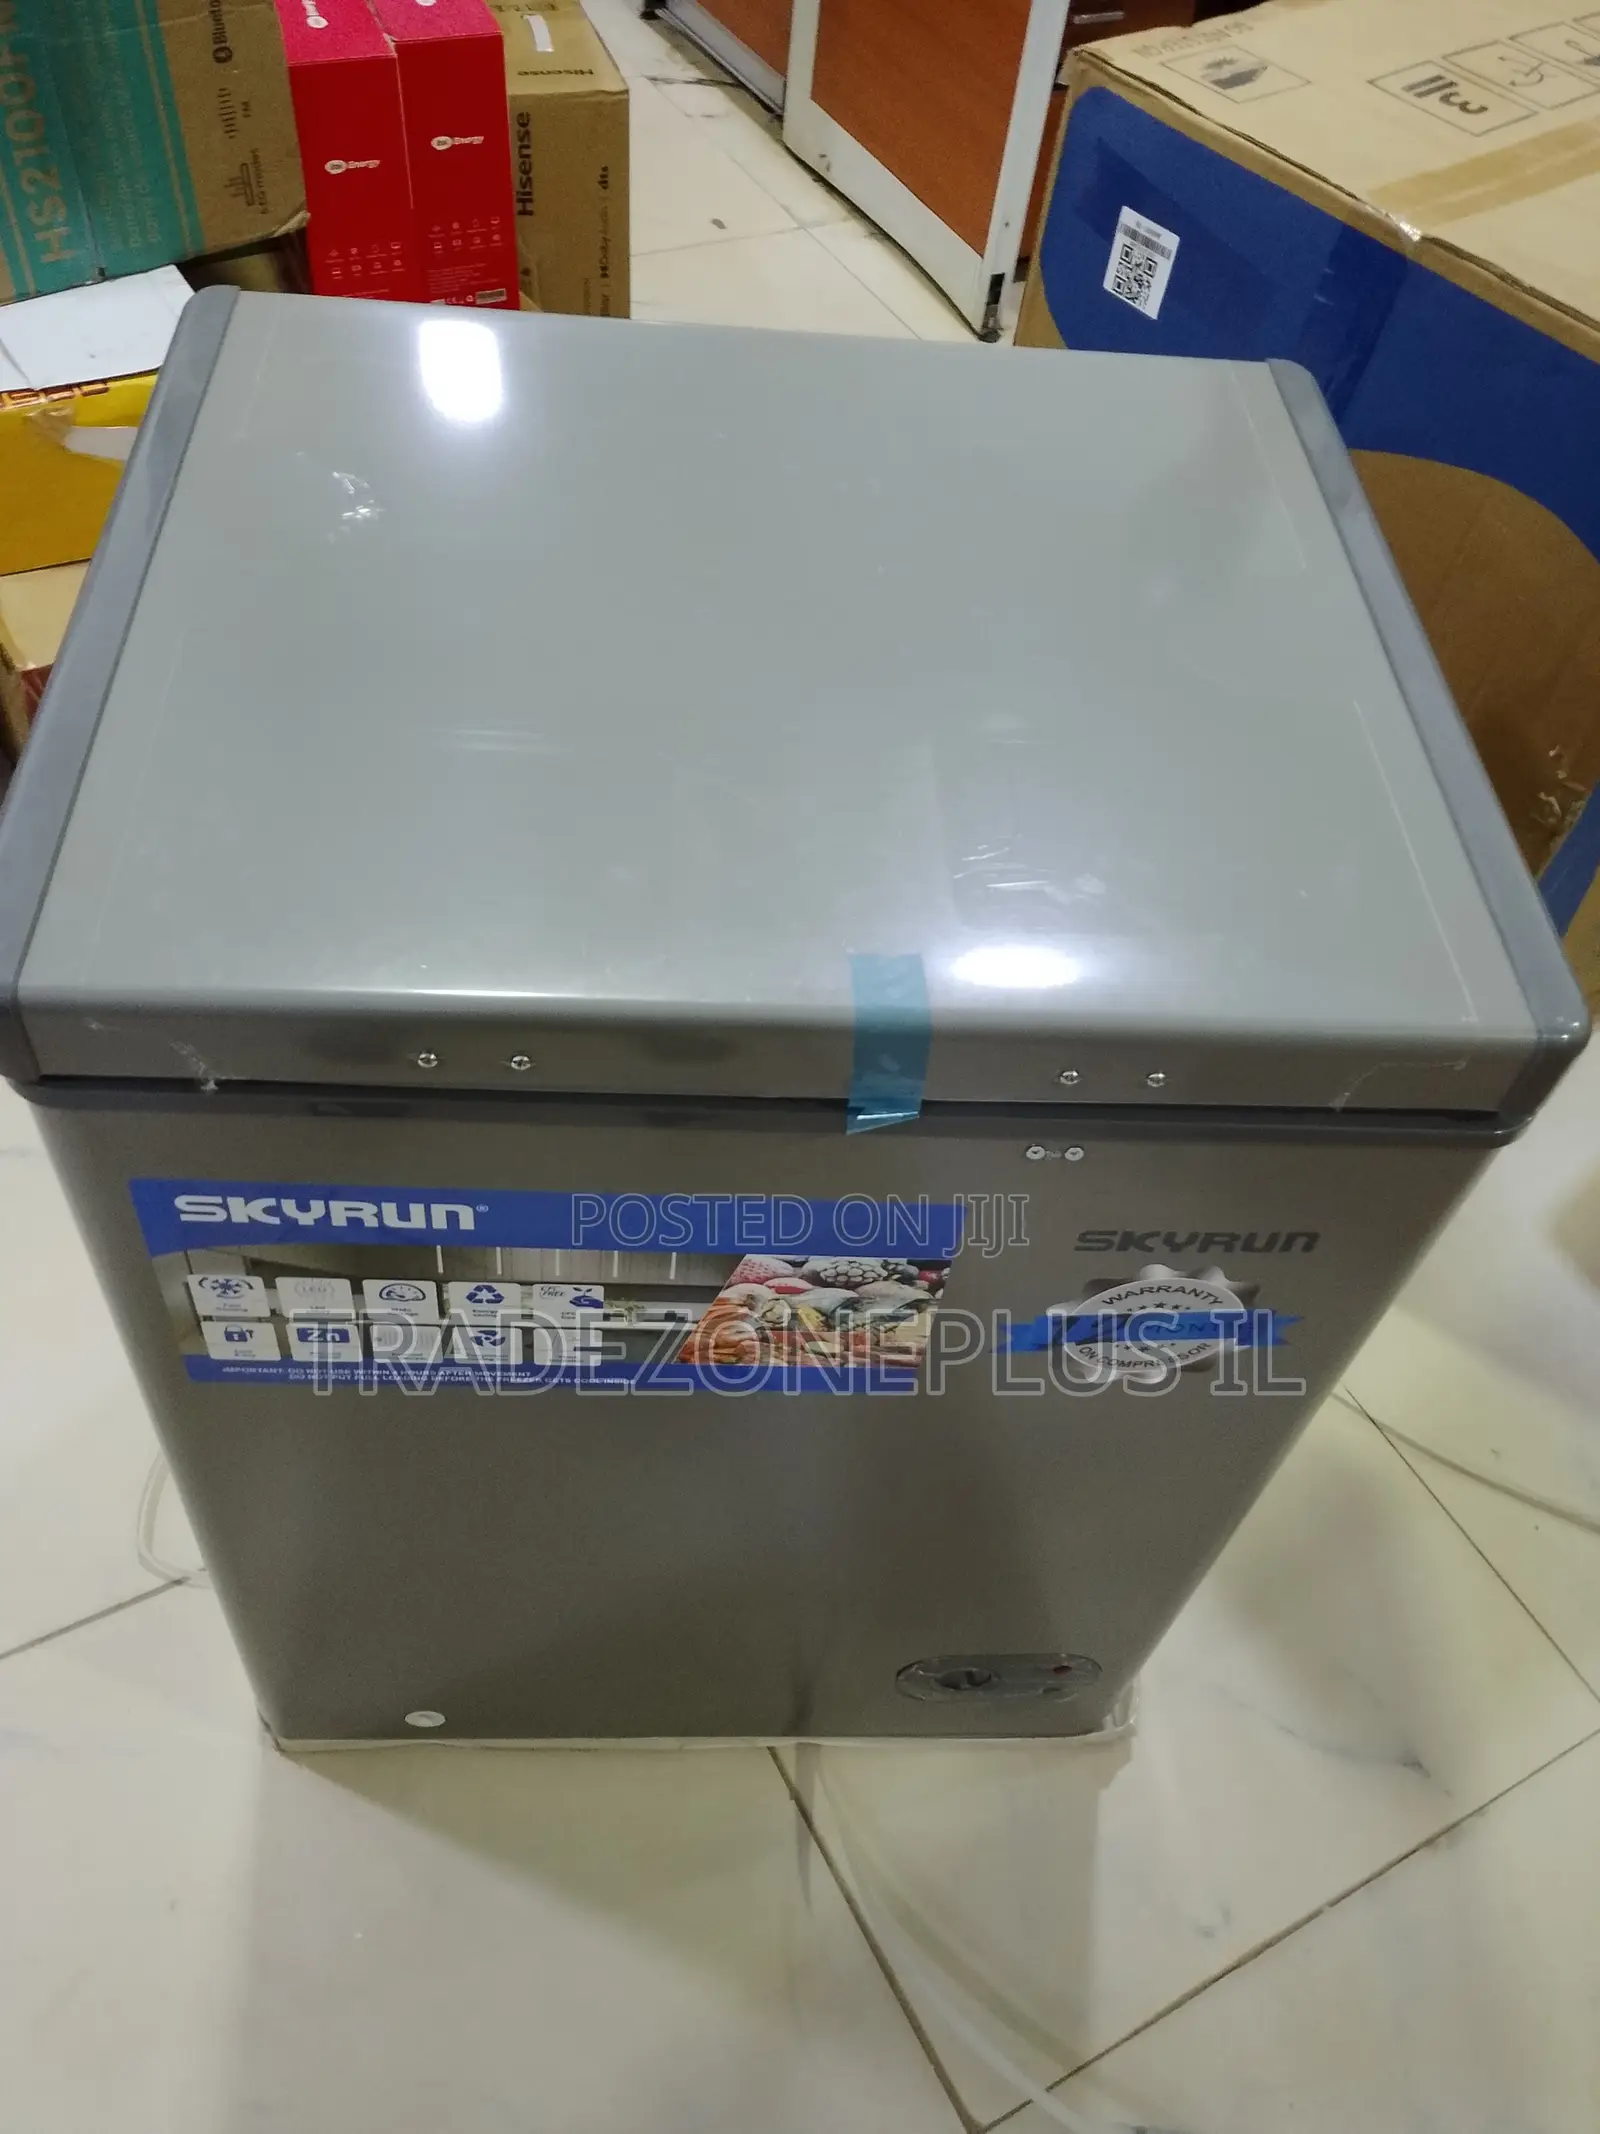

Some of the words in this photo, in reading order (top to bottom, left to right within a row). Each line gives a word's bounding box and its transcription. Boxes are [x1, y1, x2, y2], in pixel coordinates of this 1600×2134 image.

[515, 111, 534, 217] Hisense
[1074, 1229, 1321, 1253] SKYRUN
[1101, 1283, 1223, 1306] WARRANTY
[307, 1329, 341, 1342] Zn
